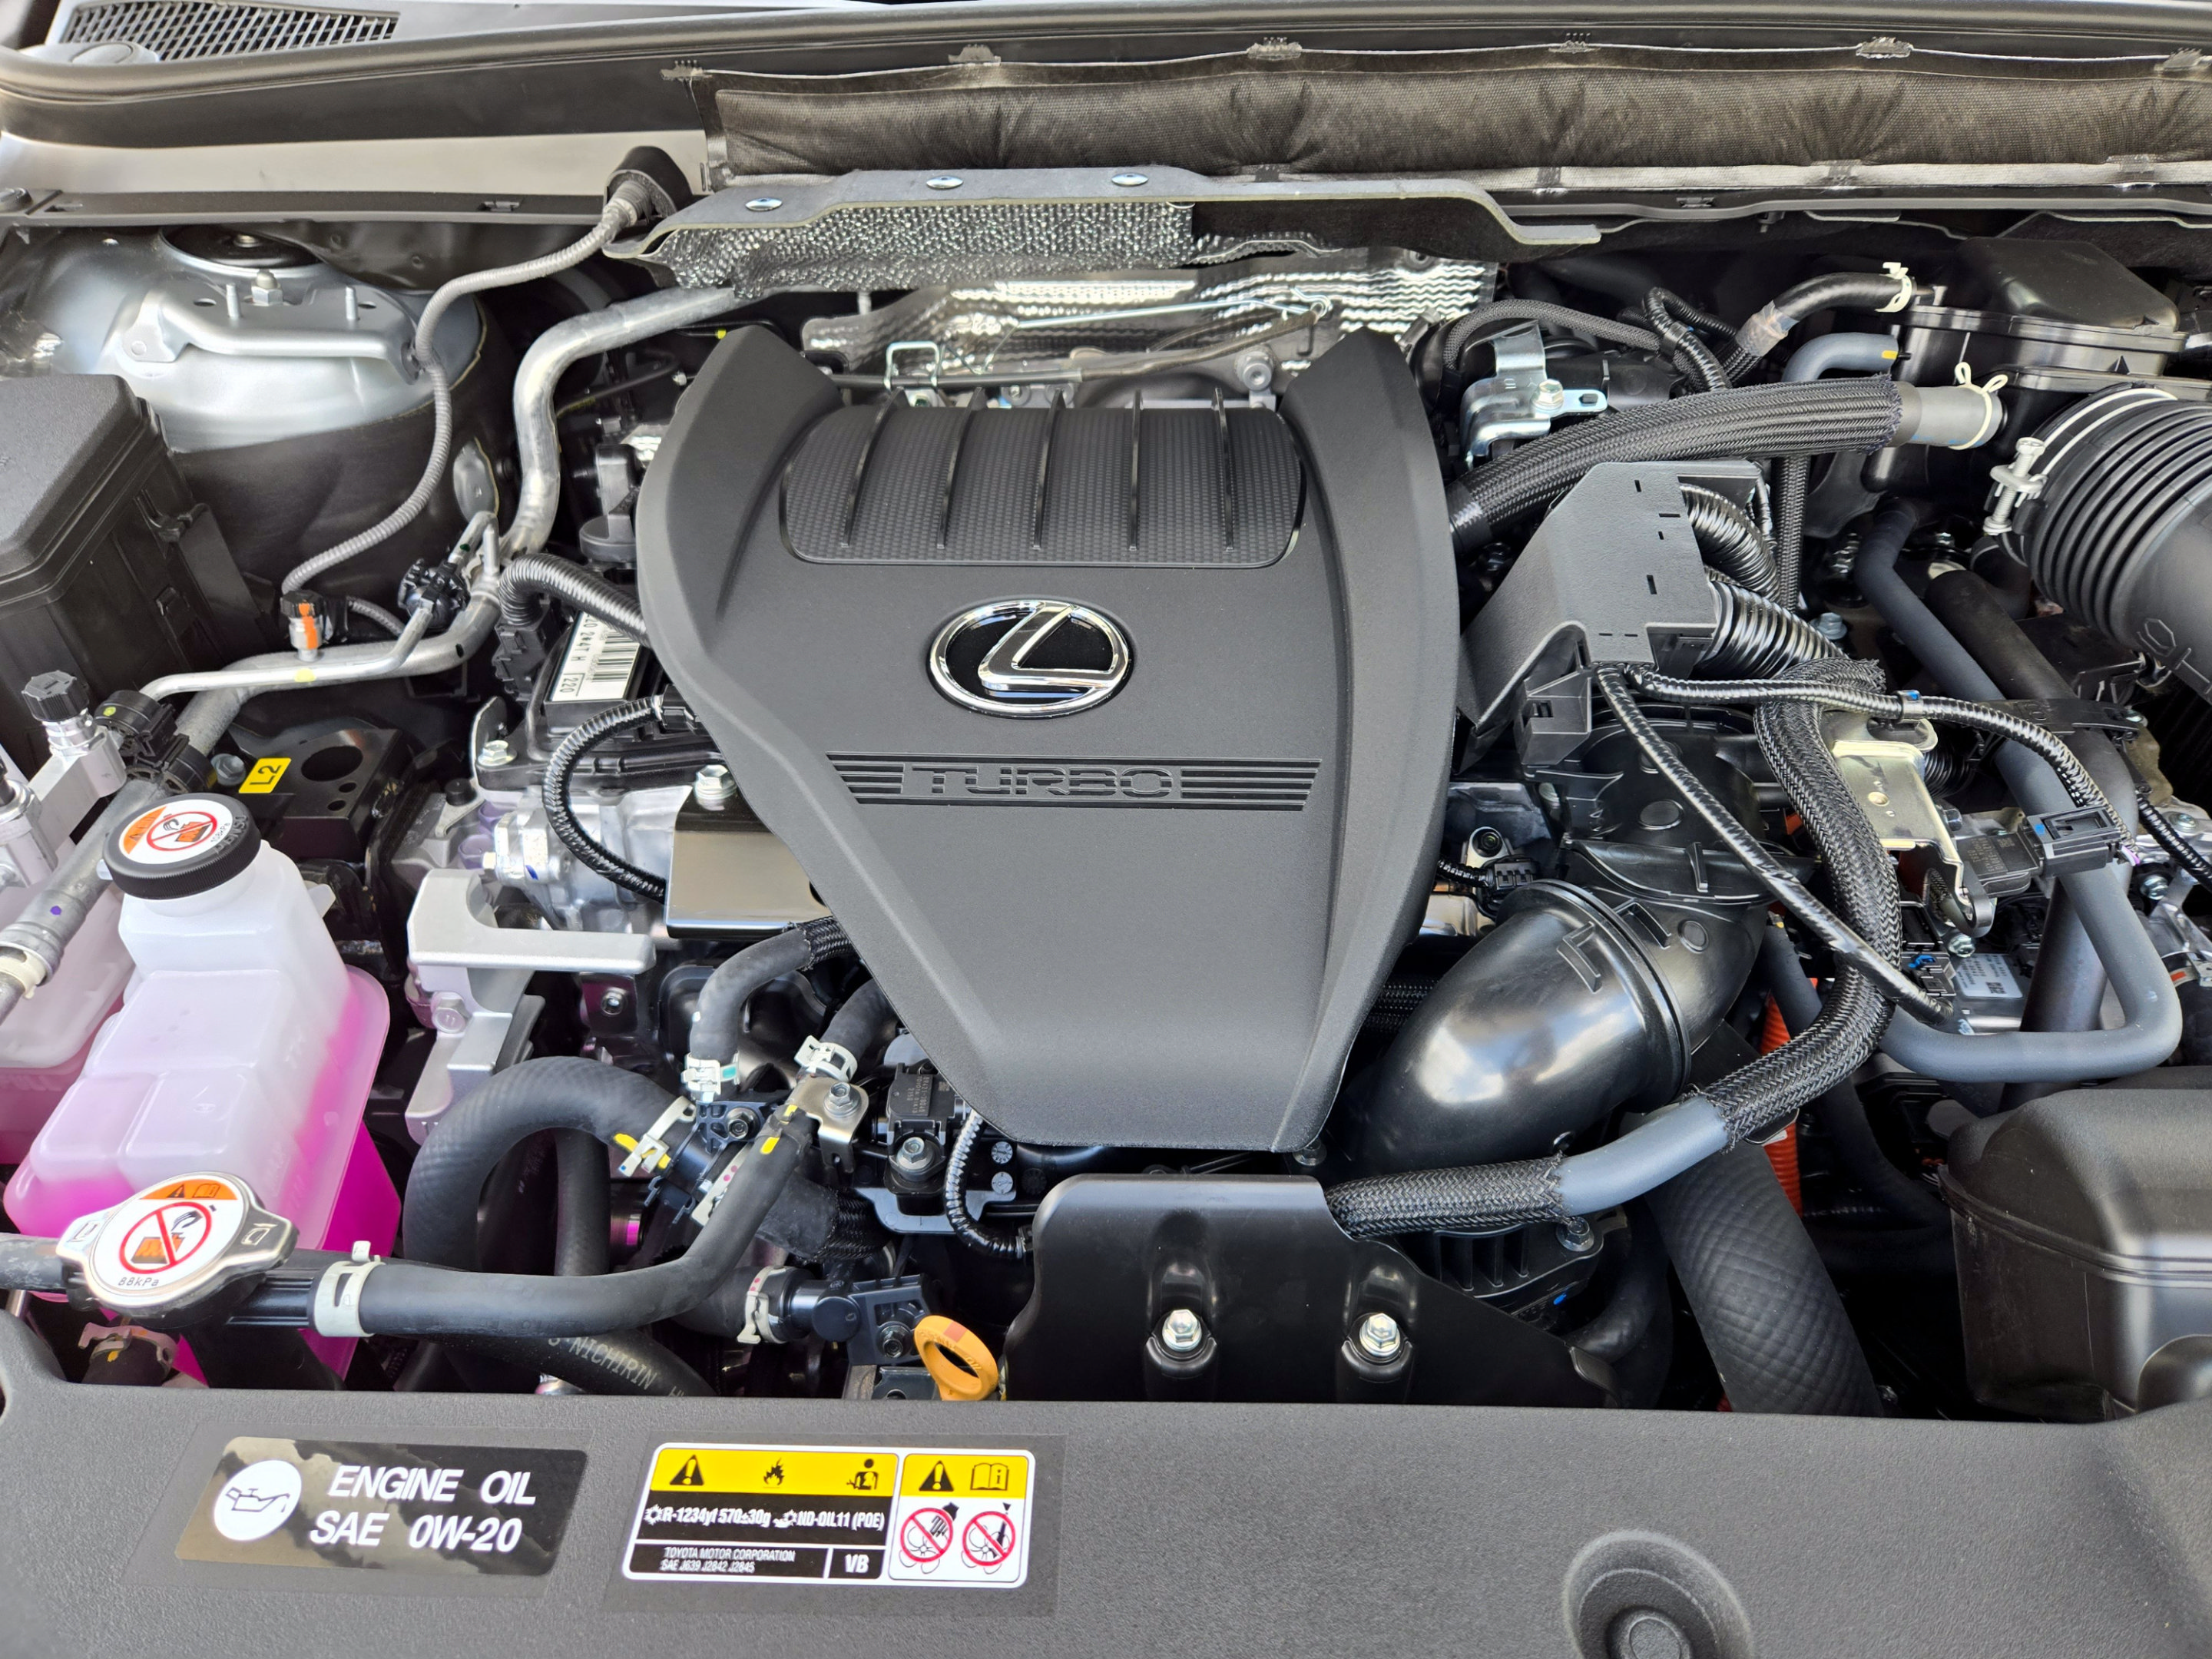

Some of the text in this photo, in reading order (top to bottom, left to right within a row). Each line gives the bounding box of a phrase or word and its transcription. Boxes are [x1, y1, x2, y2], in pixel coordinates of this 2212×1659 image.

[559, 677, 579, 694] 220
[249, 765, 282, 785] L2
[912, 765, 1174, 797] TURBO
[214, 814, 247, 854] DENSO
[118, 1277, 160, 1286] 88kPa
[569, 1337, 658, 1391] NICHIRIN
[328, 1465, 537, 1505] ENGINE OIL
[661, 1506, 886, 1532] R-1234yf 570±30g ND-OIL11 (POE)
[310, 1510, 523, 1553] SAE 0W-20
[664, 1546, 796, 1562] TOYOTA MOTOR CORPORATION
[845, 1554, 869, 1574] VB
[660, 1558, 755, 1575] SAE J639 J2842 J2845
